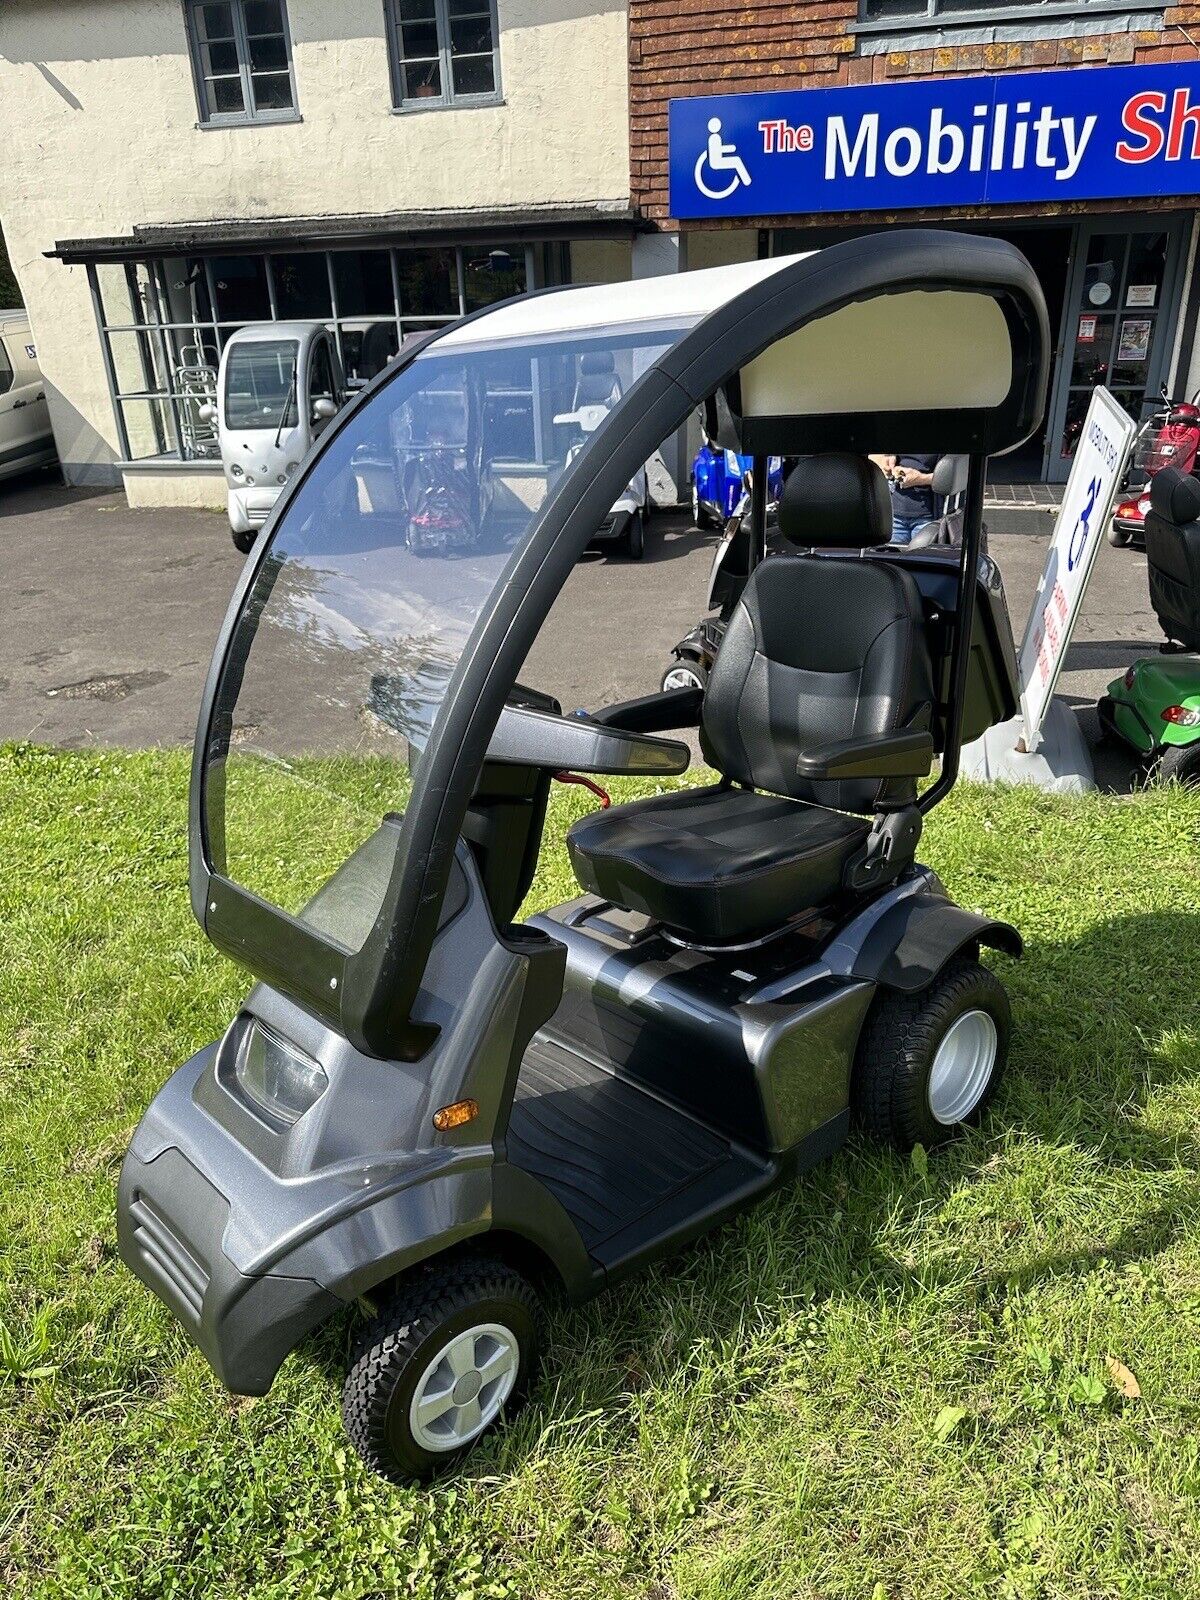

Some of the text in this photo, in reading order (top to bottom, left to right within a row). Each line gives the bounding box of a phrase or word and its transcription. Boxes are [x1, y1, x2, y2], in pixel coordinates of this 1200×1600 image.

[758, 87, 1200, 180] The Mobility Sh
